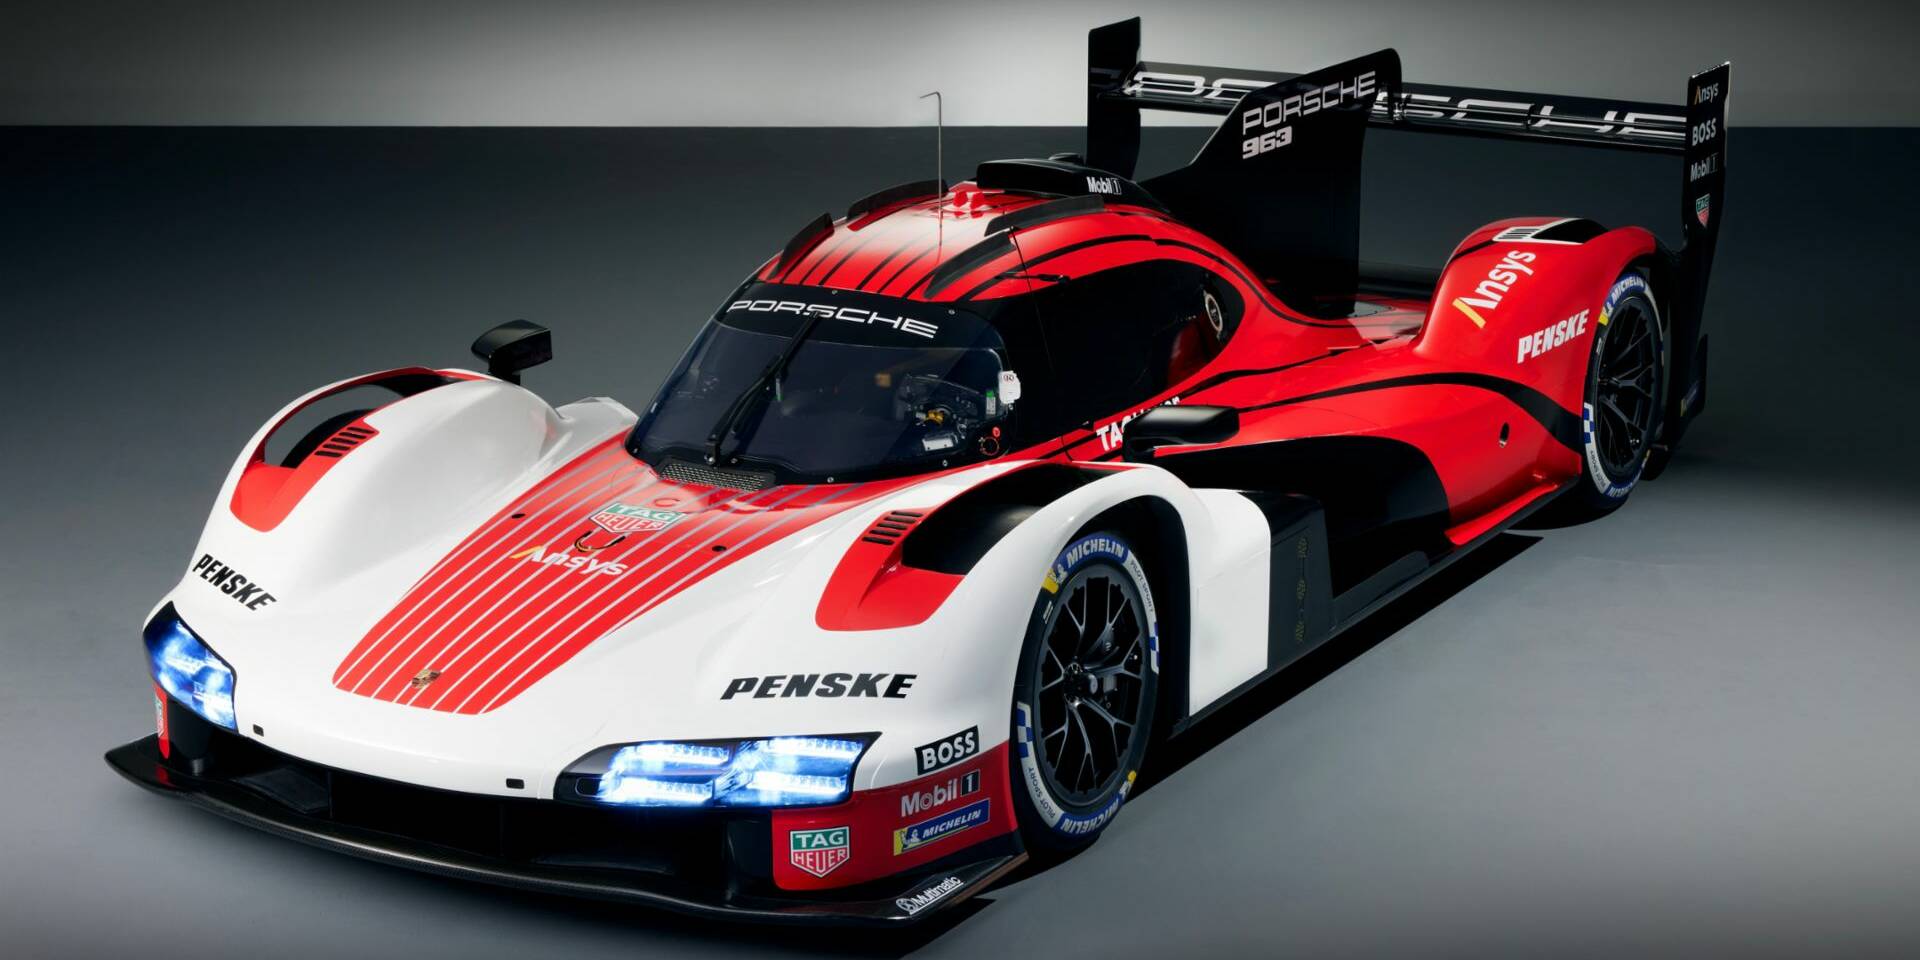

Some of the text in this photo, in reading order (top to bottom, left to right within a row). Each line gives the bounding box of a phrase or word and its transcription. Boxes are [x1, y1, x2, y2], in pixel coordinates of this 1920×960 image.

[1243, 71, 1376, 136] PORSCHE
[1694, 82, 1719, 105] Ansys
[1242, 126, 1292, 159] 963
[1692, 118, 1717, 147] BOSS
[1690, 155, 1710, 182] Mobil
[1086, 176, 1112, 193] Mobil
[1452, 250, 1537, 329] Ansys
[1611, 276, 1645, 304] MICHELIN
[727, 300, 939, 339] PORSCHE
[1517, 309, 1590, 364] PENSKE
[597, 512, 664, 531] HEUER
[615, 504, 677, 521] TAG
[510, 545, 628, 575] Ansys
[1066, 538, 1124, 568] MICHELIN
[192, 553, 277, 611] PENSKE
[720, 672, 917, 700] PENSKE
[922, 731, 975, 770] BOSS
[901, 774, 974, 817] Mobil 1
[1028, 767, 1056, 818] PILOT SPORT
[922, 808, 982, 839] MICHELIN
[795, 831, 844, 848] TAG
[794, 849, 846, 874] HEUER
[913, 875, 962, 910] Multimatic
